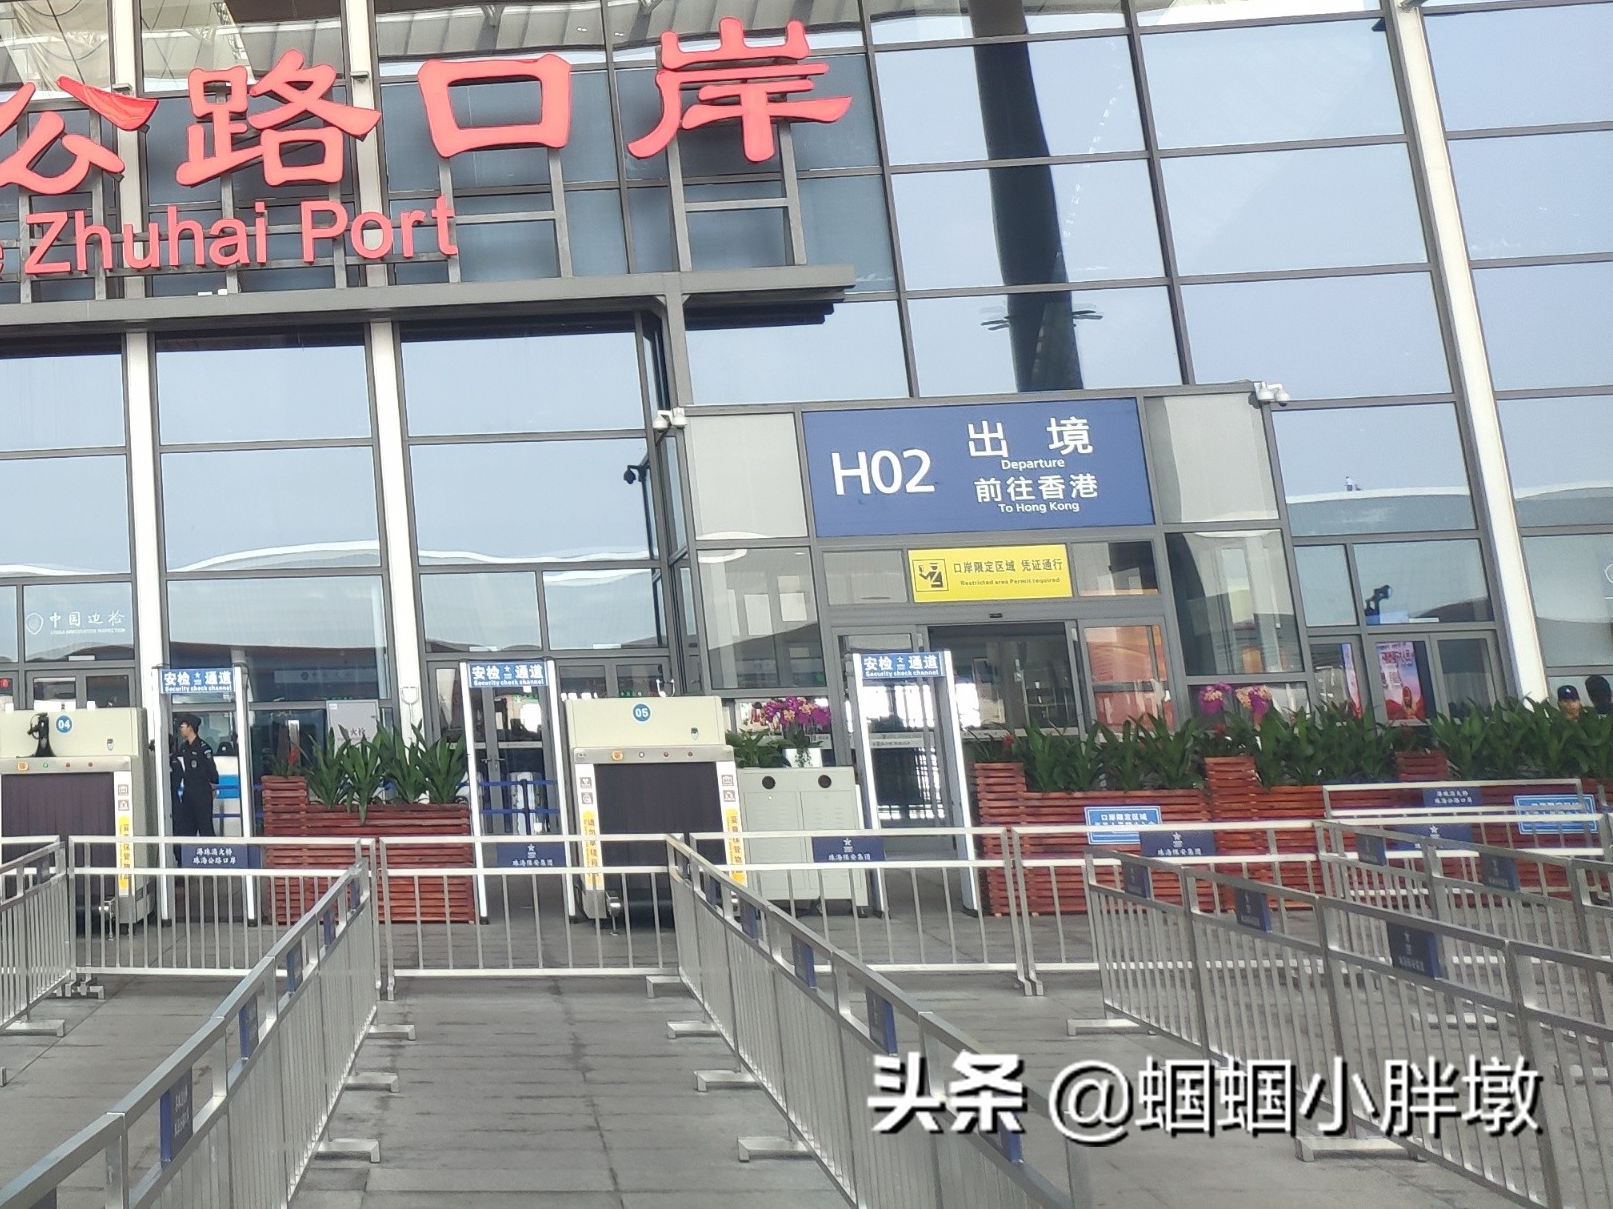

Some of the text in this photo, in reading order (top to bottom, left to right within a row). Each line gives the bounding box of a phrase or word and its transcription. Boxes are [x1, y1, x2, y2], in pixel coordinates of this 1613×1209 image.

[25, 200, 268, 276] Zhuhai
[301, 195, 458, 264] Port
[967, 416, 1093, 458] 出境
[830, 448, 935, 496] H02
[1001, 457, 1065, 471] Departure
[973, 472, 1098, 504] 前往香港
[998, 500, 1080, 514] To Hong Kong
[953, 558, 1063, 573] 口岸限定区域 凭证通行
[48, 610, 125, 628] 中国边检
[864, 654, 938, 671] 安检 通道
[164, 670, 231, 686] 安检 通道
[472, 664, 544, 680] 安检 通道
[865, 670, 893, 678] Security
[634, 708, 649, 719] 05
[57, 719, 71, 730] 04
